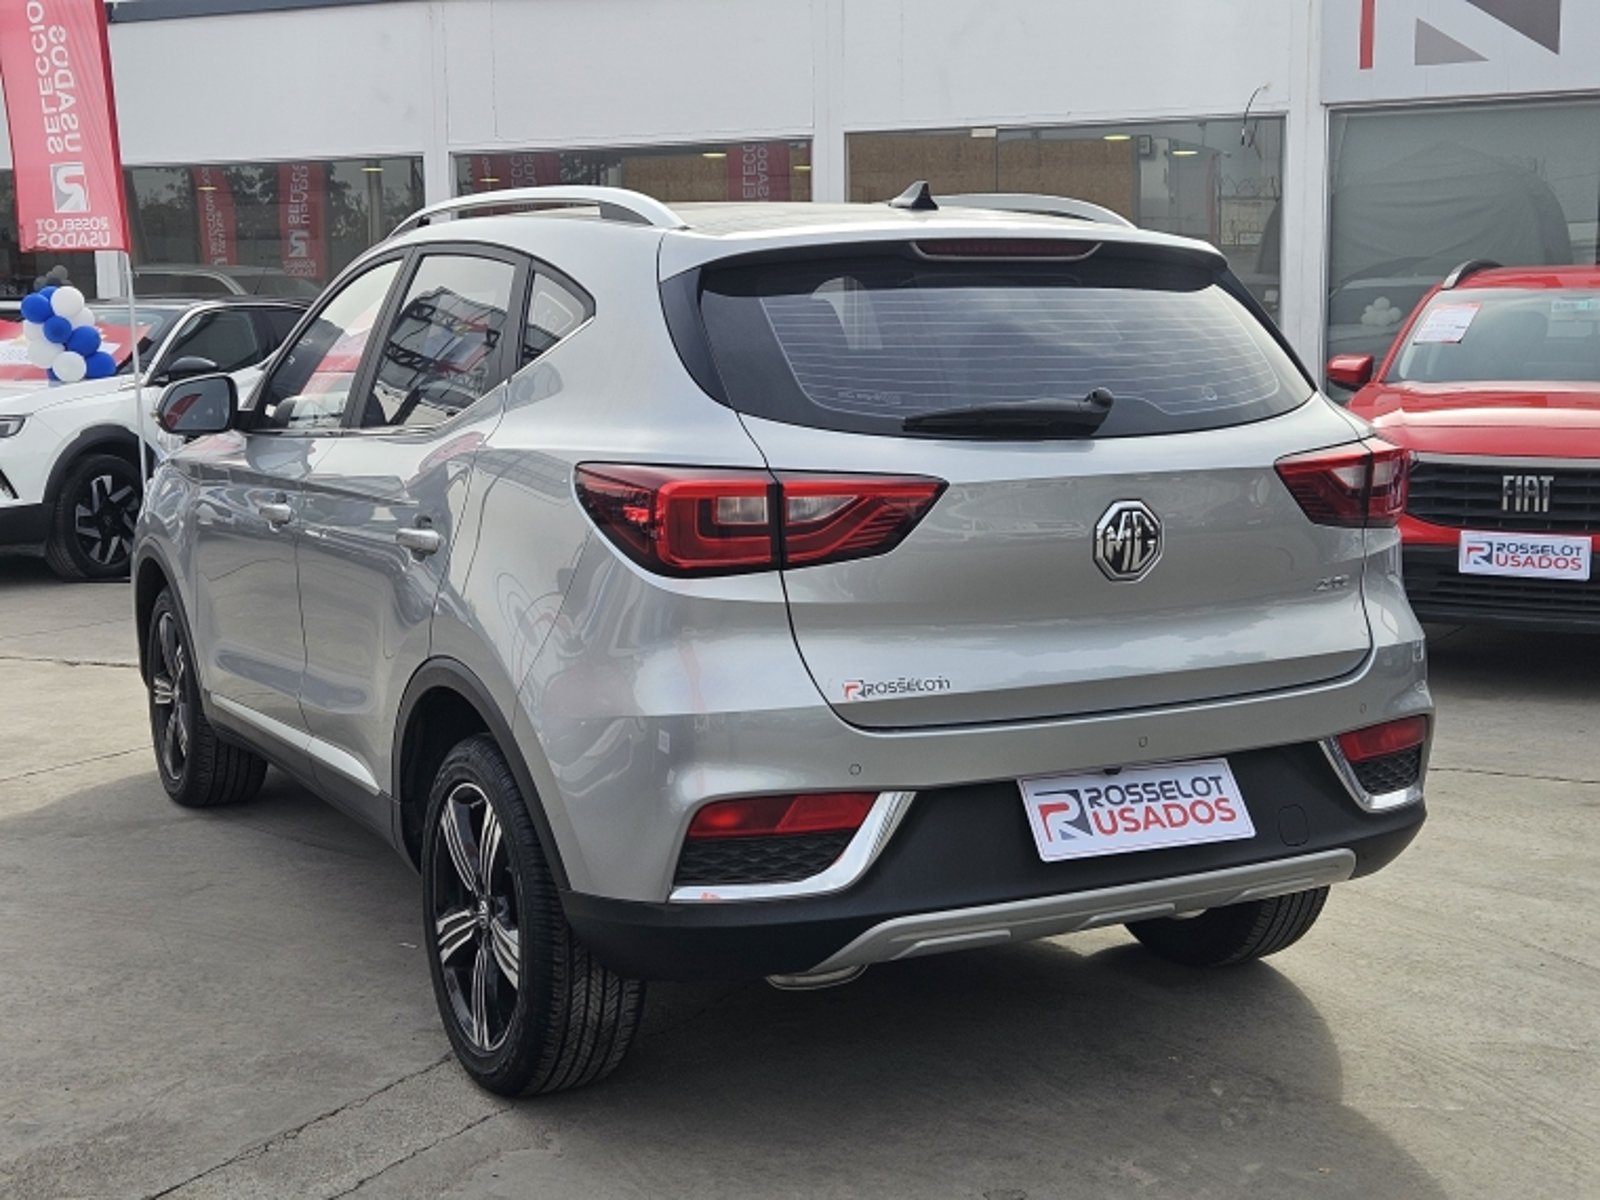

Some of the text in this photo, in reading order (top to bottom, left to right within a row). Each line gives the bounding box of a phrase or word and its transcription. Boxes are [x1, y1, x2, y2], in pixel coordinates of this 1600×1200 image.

[1502, 475, 1554, 512] FIAT
[1103, 509, 1158, 574] MG
[1496, 541, 1583, 557] ROSSELOT
[1494, 553, 1583, 572] USADOS
[1084, 775, 1223, 809] ROSSELOT
[1092, 797, 1238, 836] USADOS
